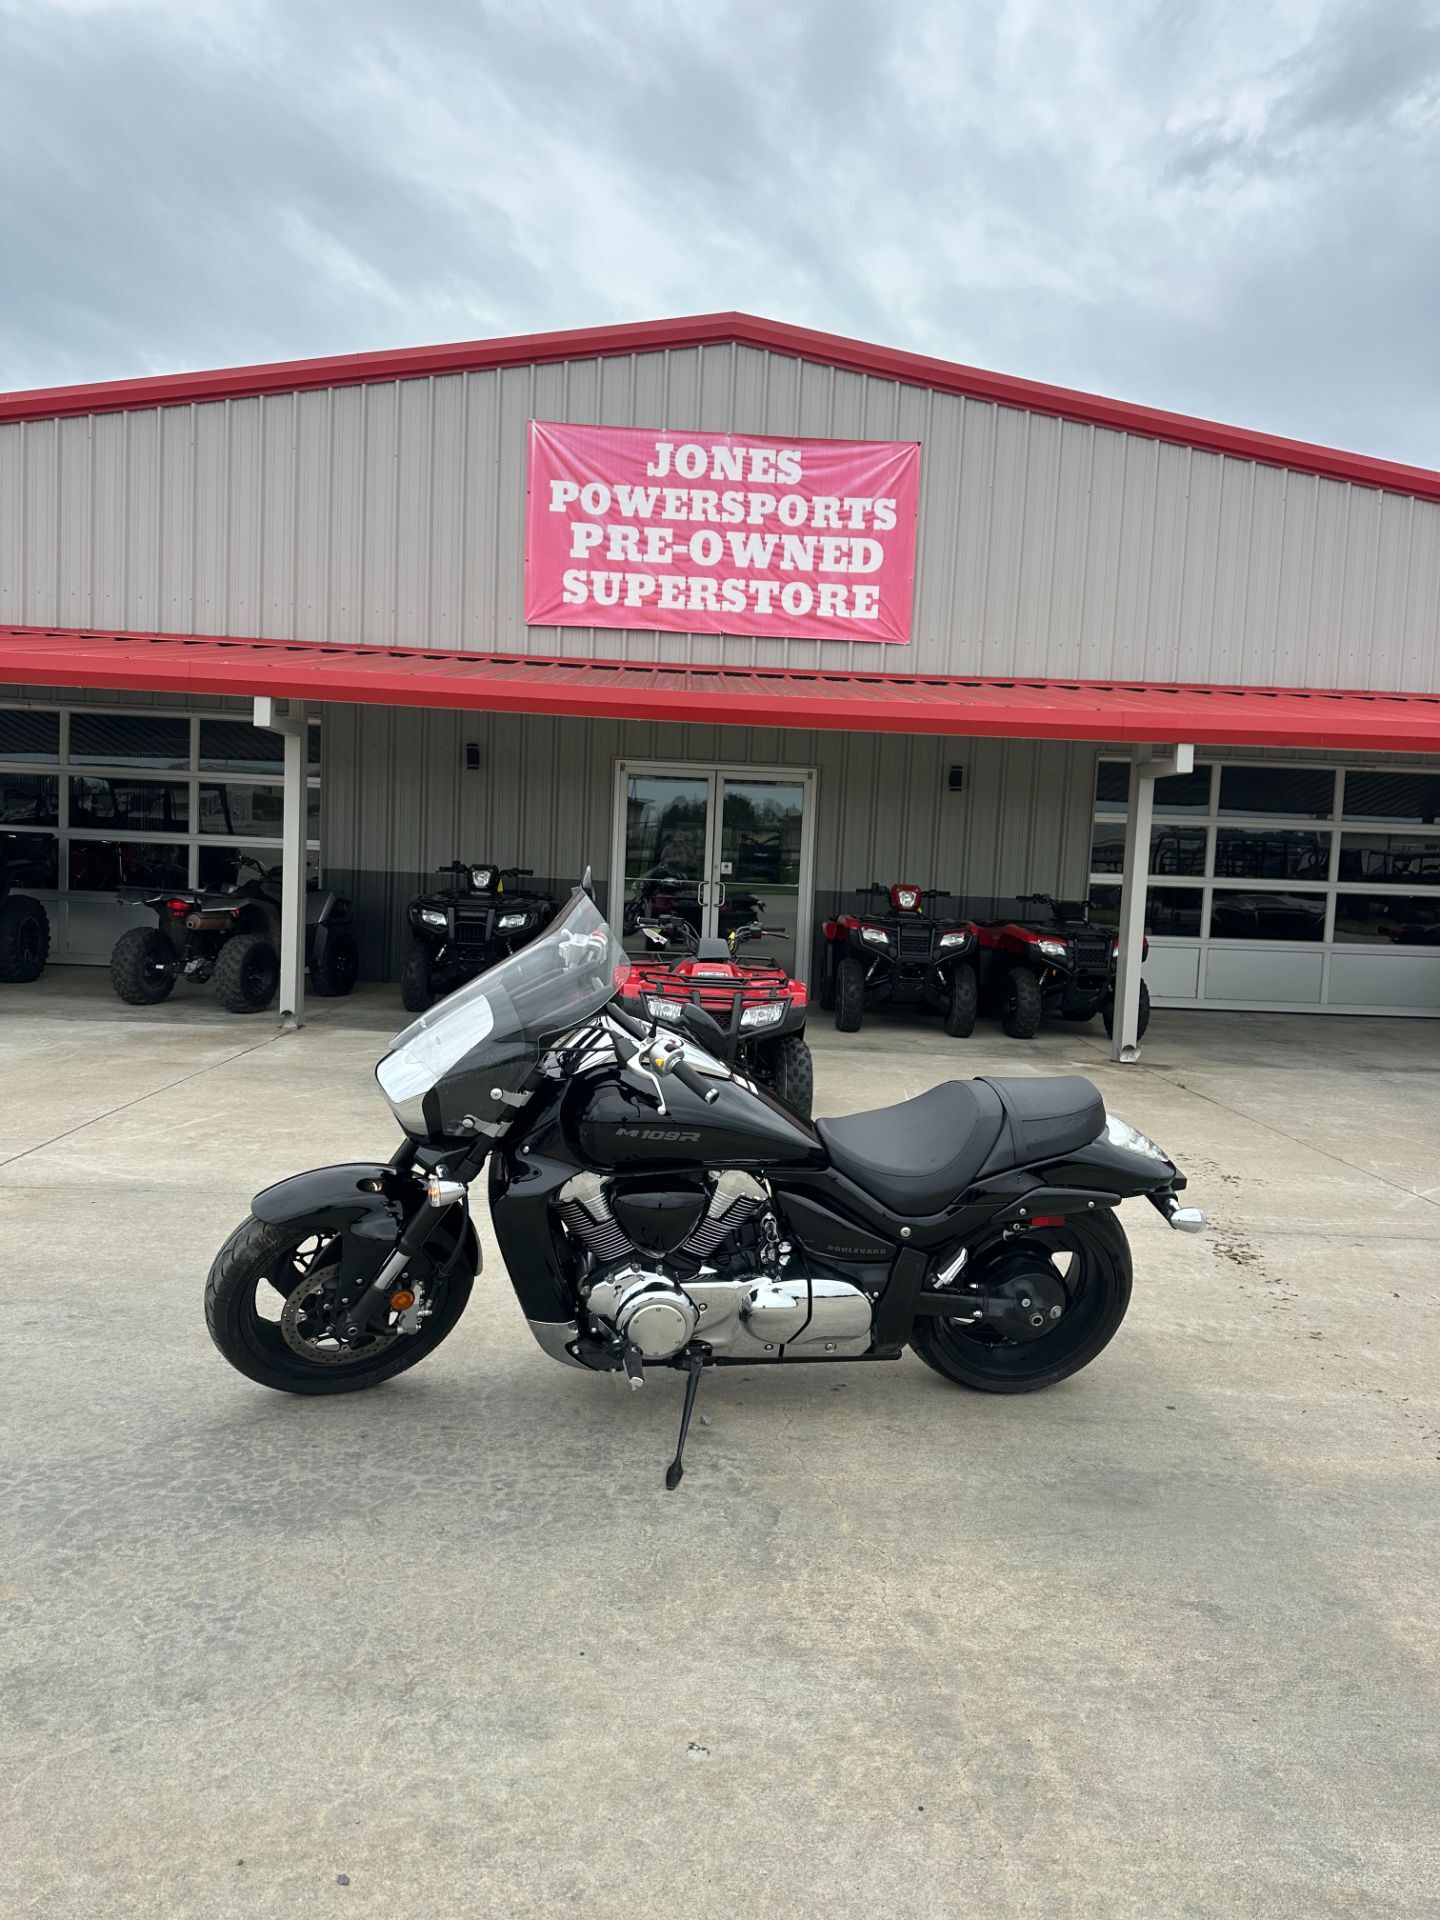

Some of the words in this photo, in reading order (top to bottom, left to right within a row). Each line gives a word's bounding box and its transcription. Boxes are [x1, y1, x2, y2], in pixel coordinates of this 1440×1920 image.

[647, 443, 803, 485] JONES
[549, 480, 897, 531] POWERSPORTS
[570, 522, 884, 574] PRE-OWNED
[562, 569, 880, 619] SUPERSTORE
